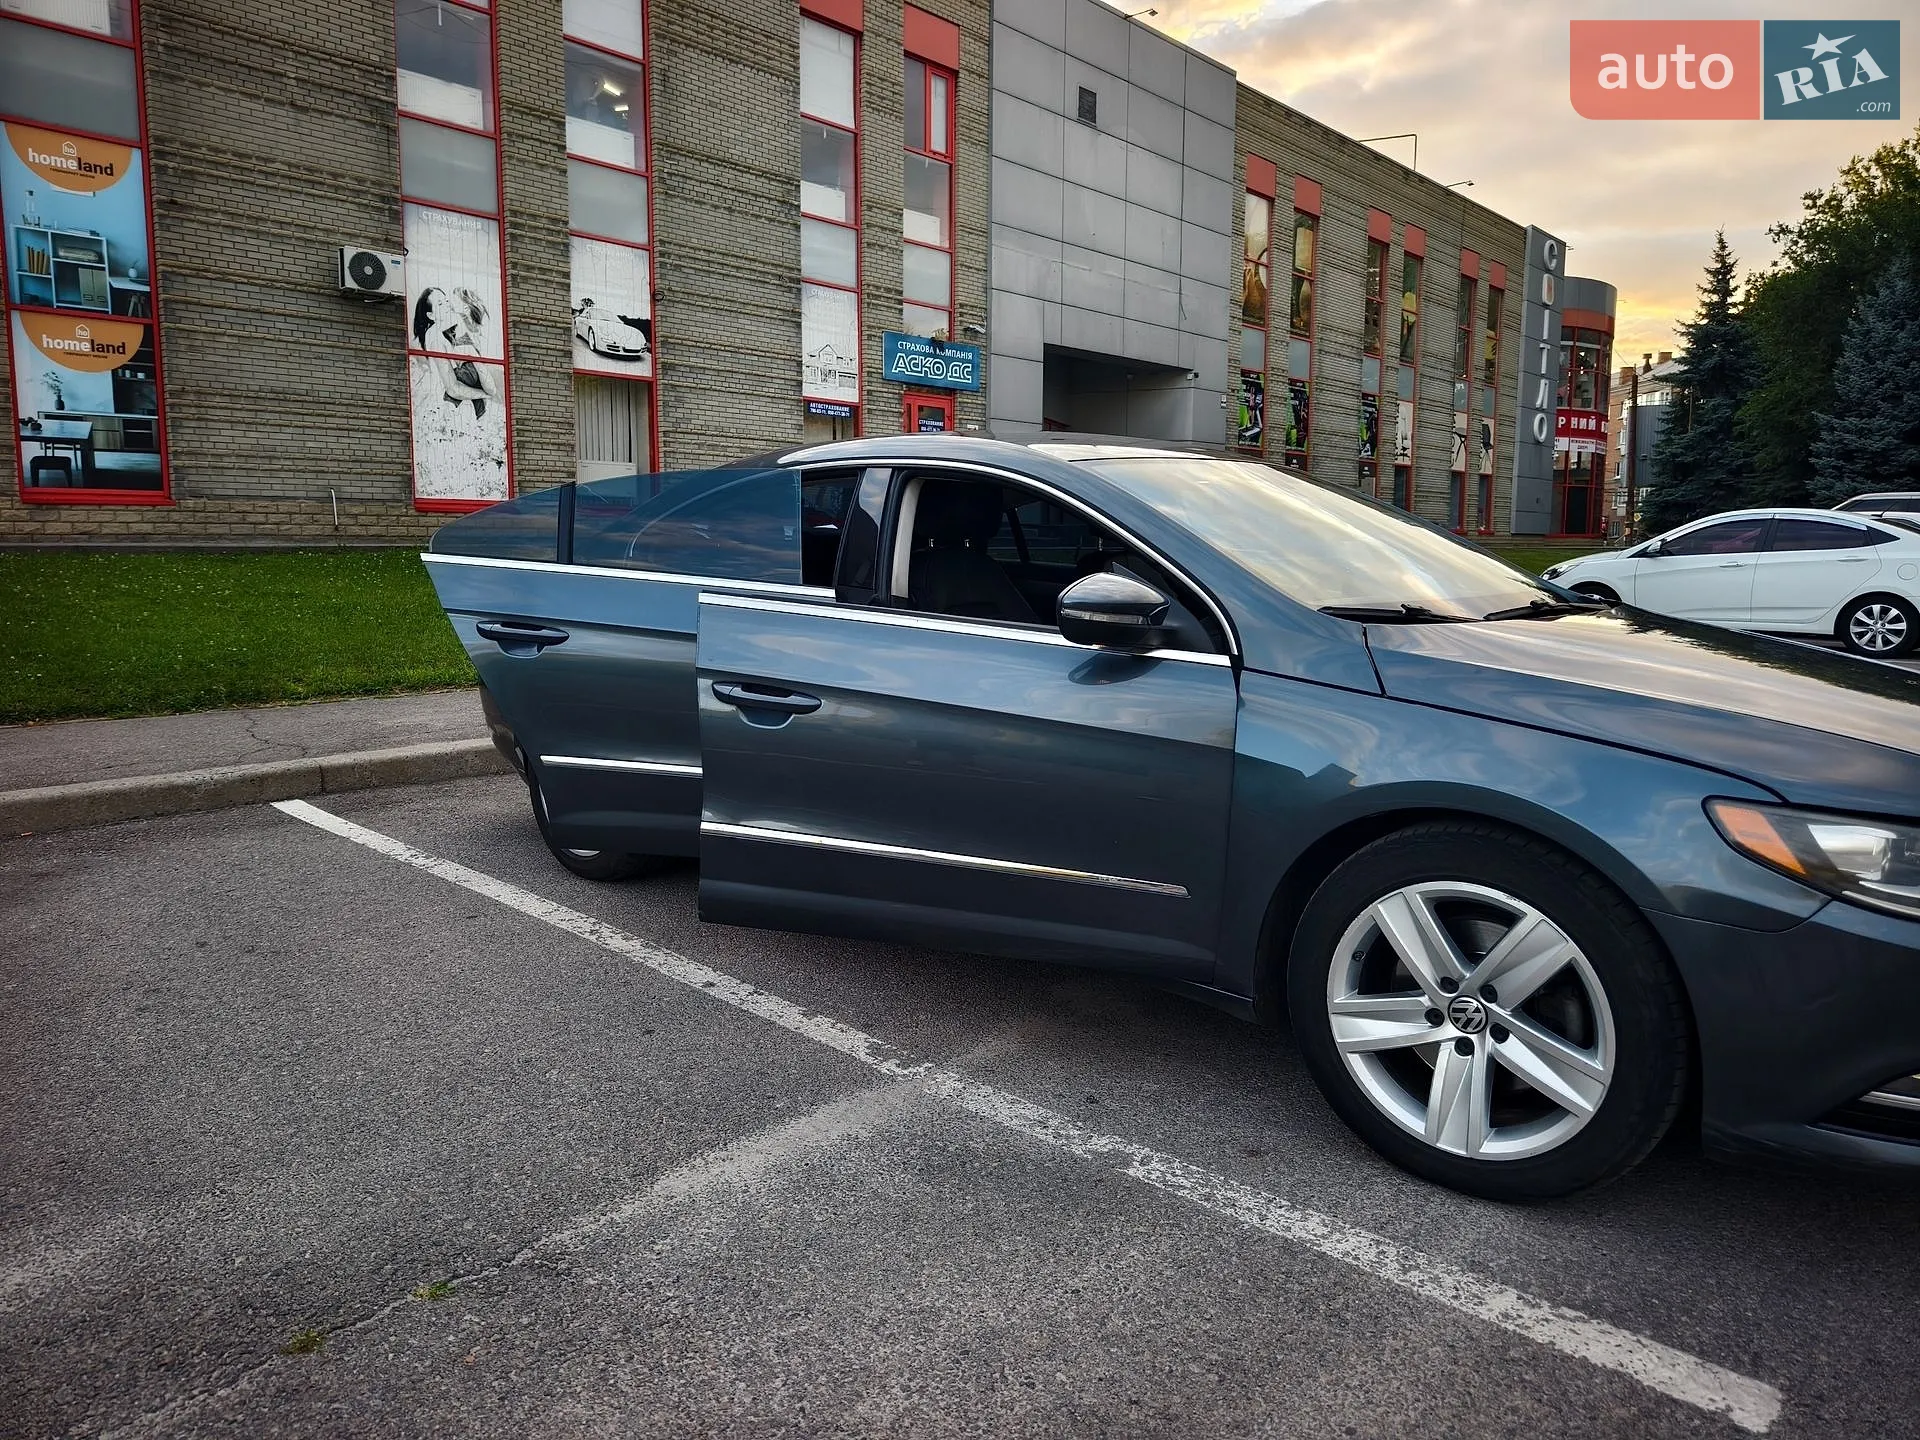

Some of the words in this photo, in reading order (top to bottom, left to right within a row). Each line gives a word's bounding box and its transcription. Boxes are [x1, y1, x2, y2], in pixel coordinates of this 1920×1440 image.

[28, 148, 114, 176] homeland
[42, 334, 126, 355] homeland
[898, 341, 934, 354] СТРАХОВА
[892, 353, 946, 379] АСКО
